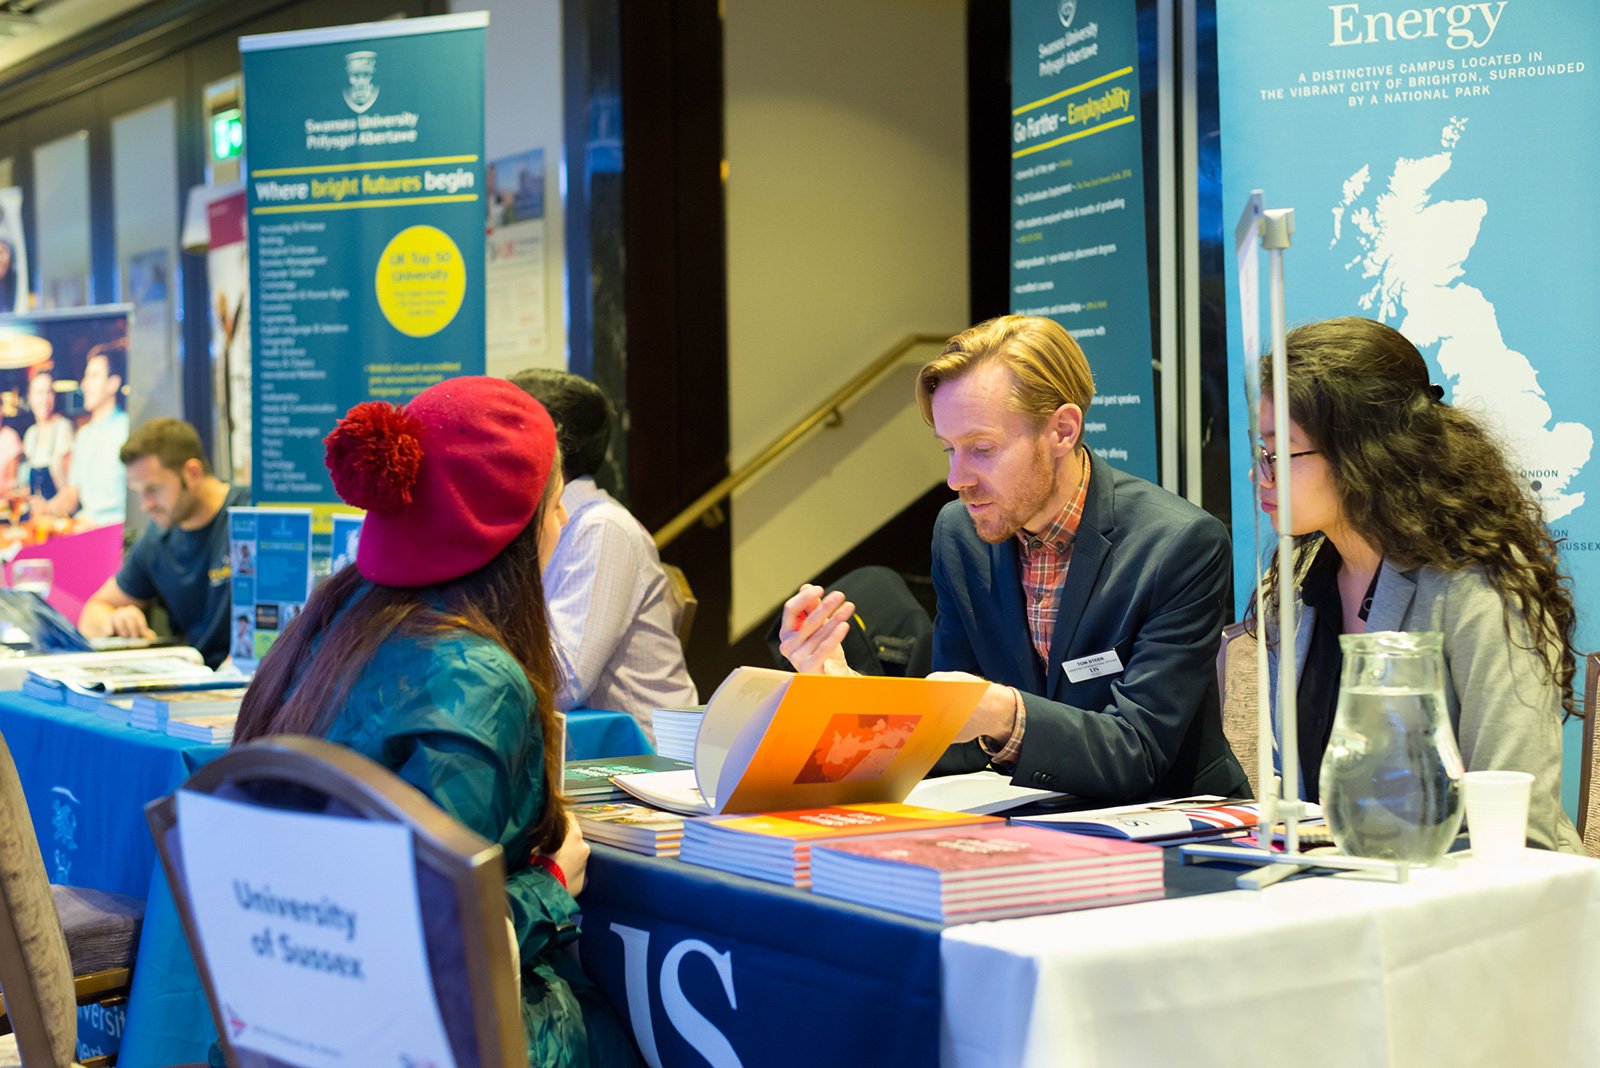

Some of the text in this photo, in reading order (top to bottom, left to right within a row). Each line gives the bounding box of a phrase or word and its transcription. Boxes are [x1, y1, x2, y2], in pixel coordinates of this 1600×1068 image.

[1328, 1, 1507, 50] Energy
[1260, 62, 1586, 100] THE VIBRANT CITY OF BRIGHTON, SURROUNDED
[1298, 51, 1543, 83] A DISTINCTIVE CAMPUS LOCATED IN
[1348, 85, 1491, 107] BY A NATIONAL PARK
[305, 112, 419, 134] Swansea University
[1014, 122, 1027, 143] Go
[1027, 113, 1059, 139] Further
[1067, 86, 1131, 125] Employability
[255, 168, 474, 201] Where bright futures begin
[411, 251, 431, 266] Top
[391, 268, 449, 284] University
[1520, 469, 1559, 478] ONDON
[233, 878, 357, 941] University
[251, 928, 366, 982] of Sussex
